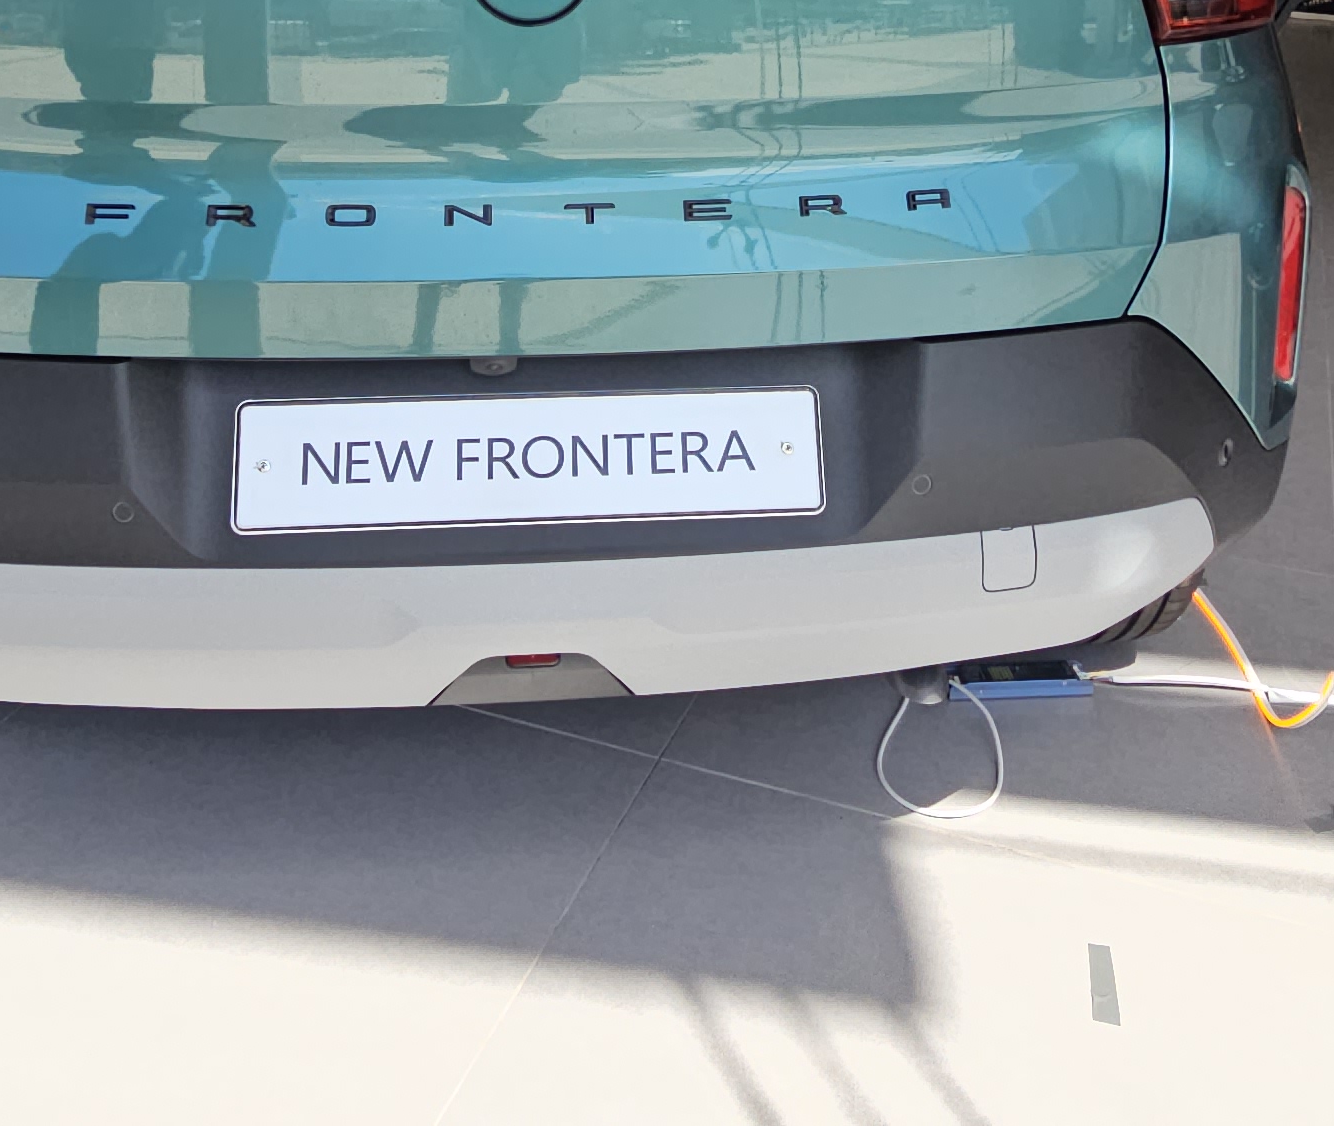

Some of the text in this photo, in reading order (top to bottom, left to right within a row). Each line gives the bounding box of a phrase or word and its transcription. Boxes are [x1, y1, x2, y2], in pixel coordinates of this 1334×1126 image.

[84, 187, 951, 227] FRONTERA
[300, 431, 755, 486] NEW FRONTERA
